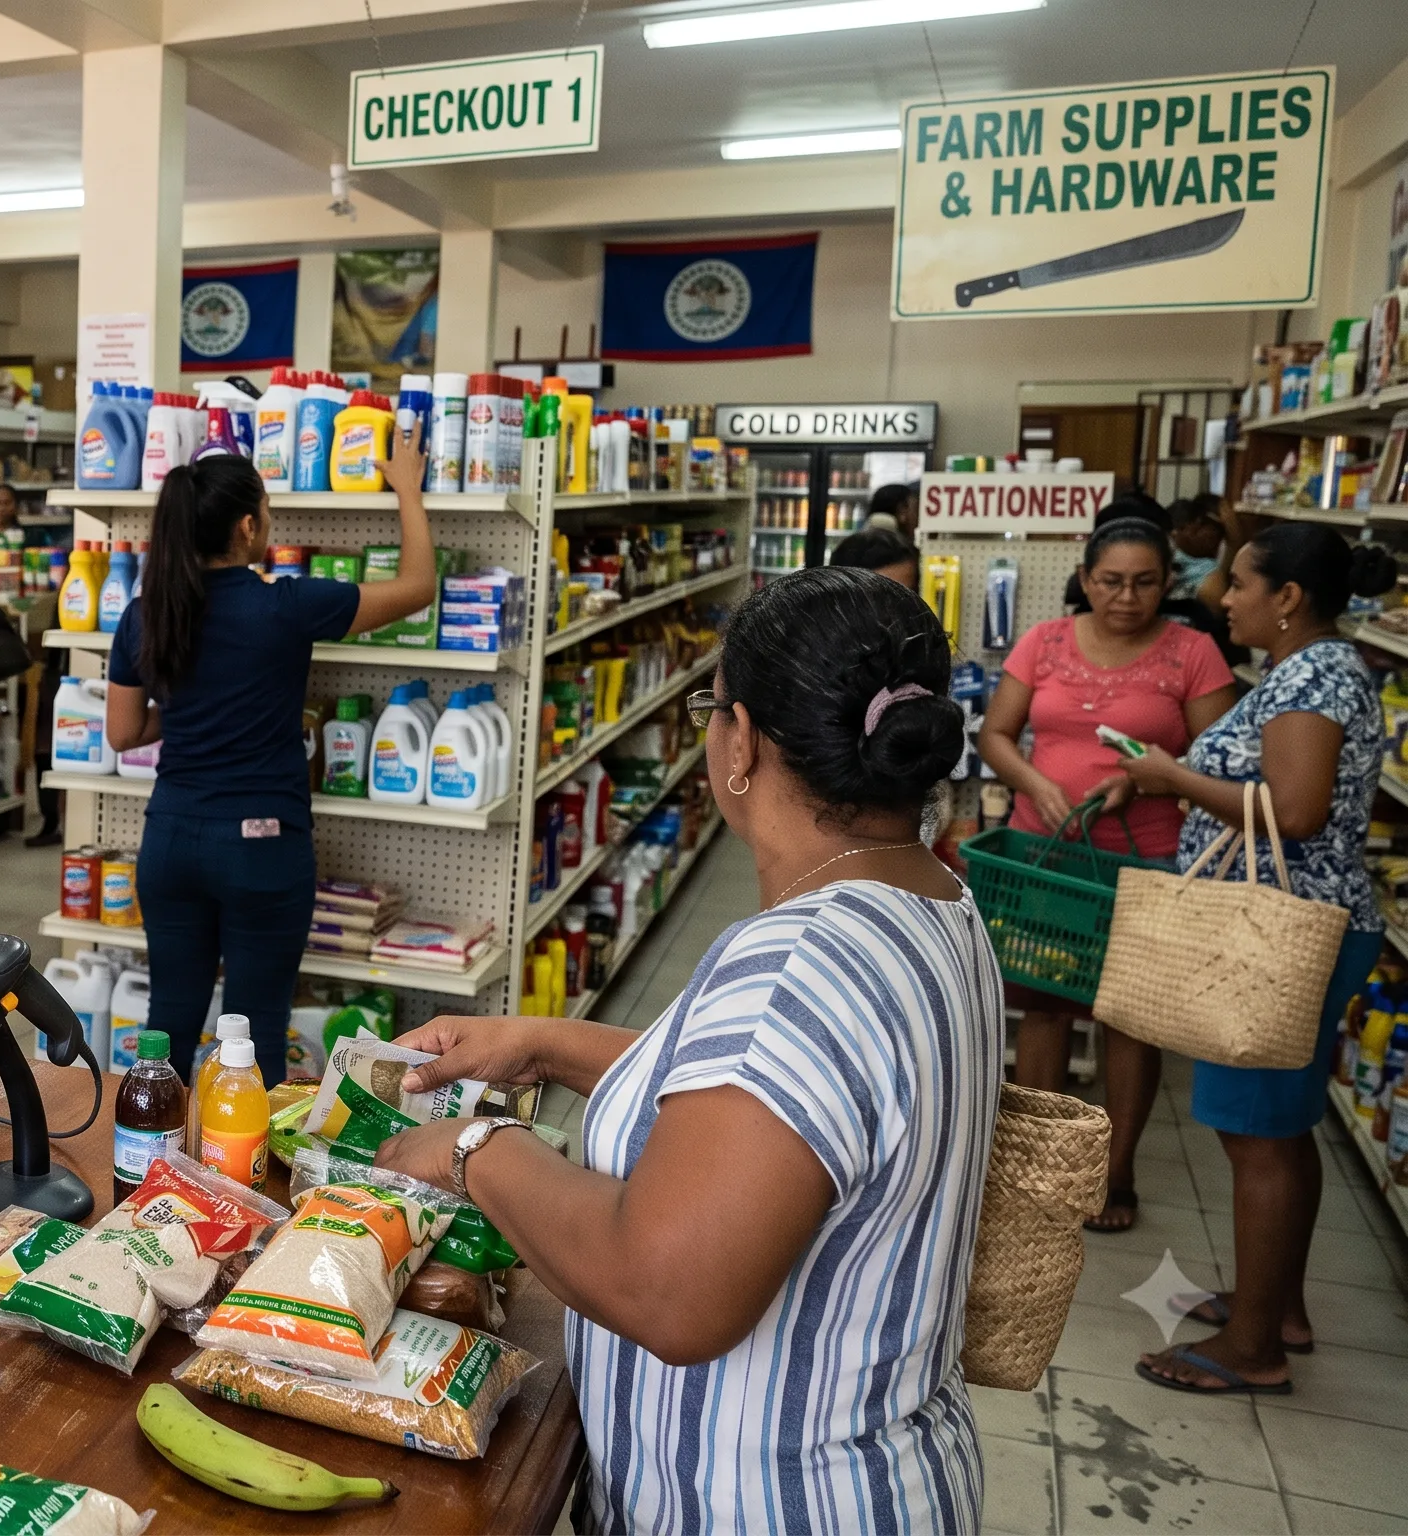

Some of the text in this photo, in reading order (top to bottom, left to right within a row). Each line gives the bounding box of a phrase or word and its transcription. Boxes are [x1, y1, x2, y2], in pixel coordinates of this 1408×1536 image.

[364, 77, 582, 141] CHECKOUT 1
[915, 85, 1313, 163] FARM SUPPLIES
[940, 151, 1278, 219] & HARDWARE
[729, 412, 920, 435] COLD DRINKS
[925, 485, 1108, 518] STATIONERY
